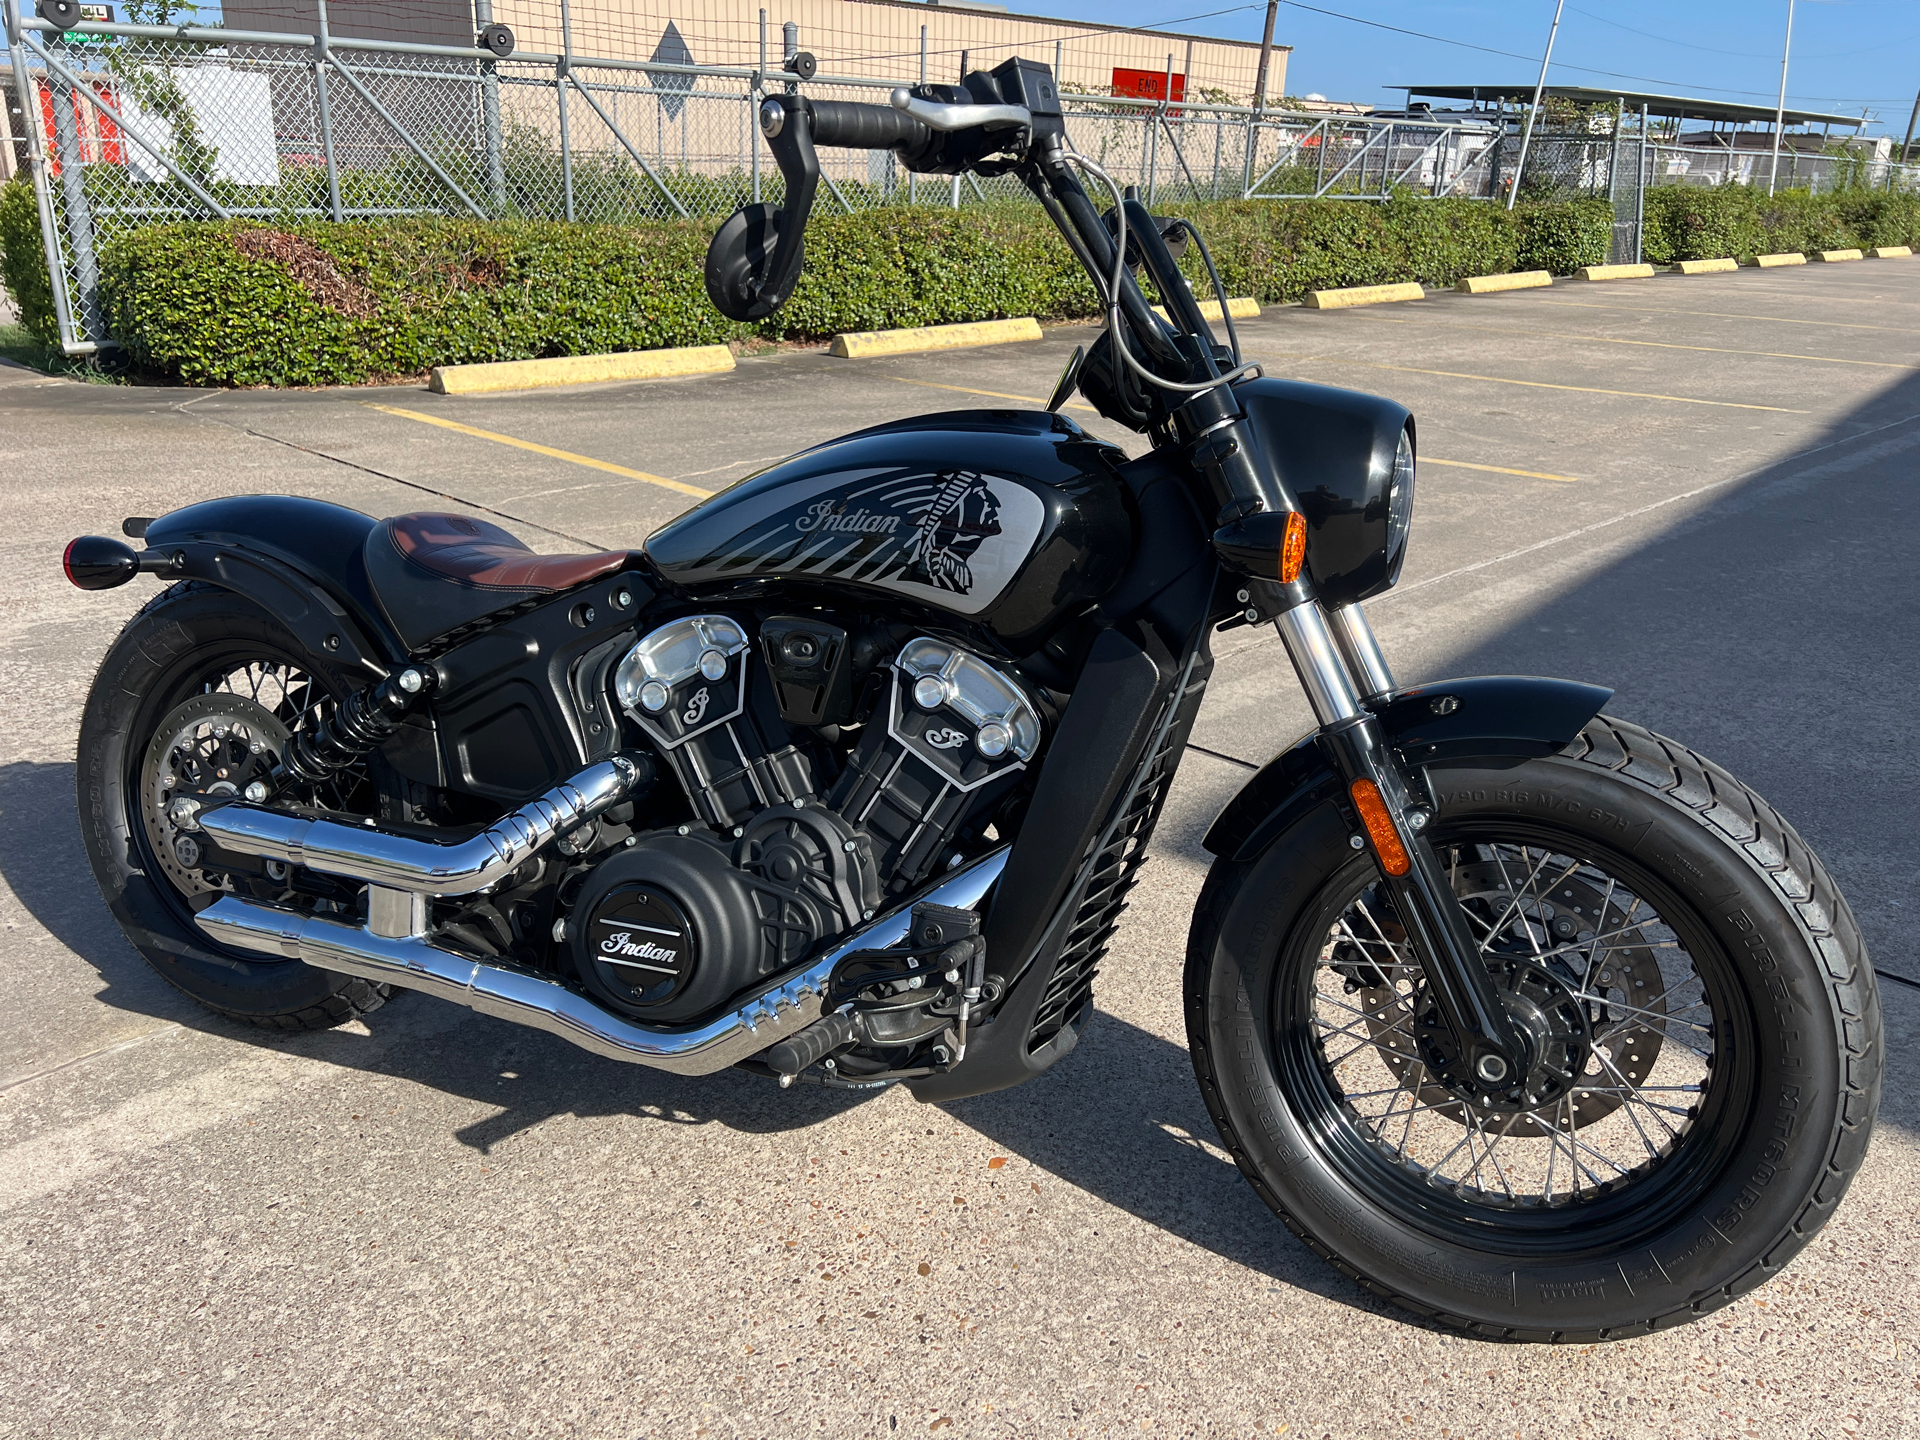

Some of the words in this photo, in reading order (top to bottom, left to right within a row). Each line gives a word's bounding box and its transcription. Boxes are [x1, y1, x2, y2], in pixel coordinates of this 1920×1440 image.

[1138, 78, 1158, 93] END
[795, 499, 902, 534] Indian
[1494, 789, 1530, 804] B16
[1536, 792, 1581, 814] M/C
[1588, 807, 1630, 833] 67H
[600, 932, 679, 963] Indian
[1726, 908, 1804, 1069] PIRELLI
[1235, 1027, 1300, 1166] PIRELLI
